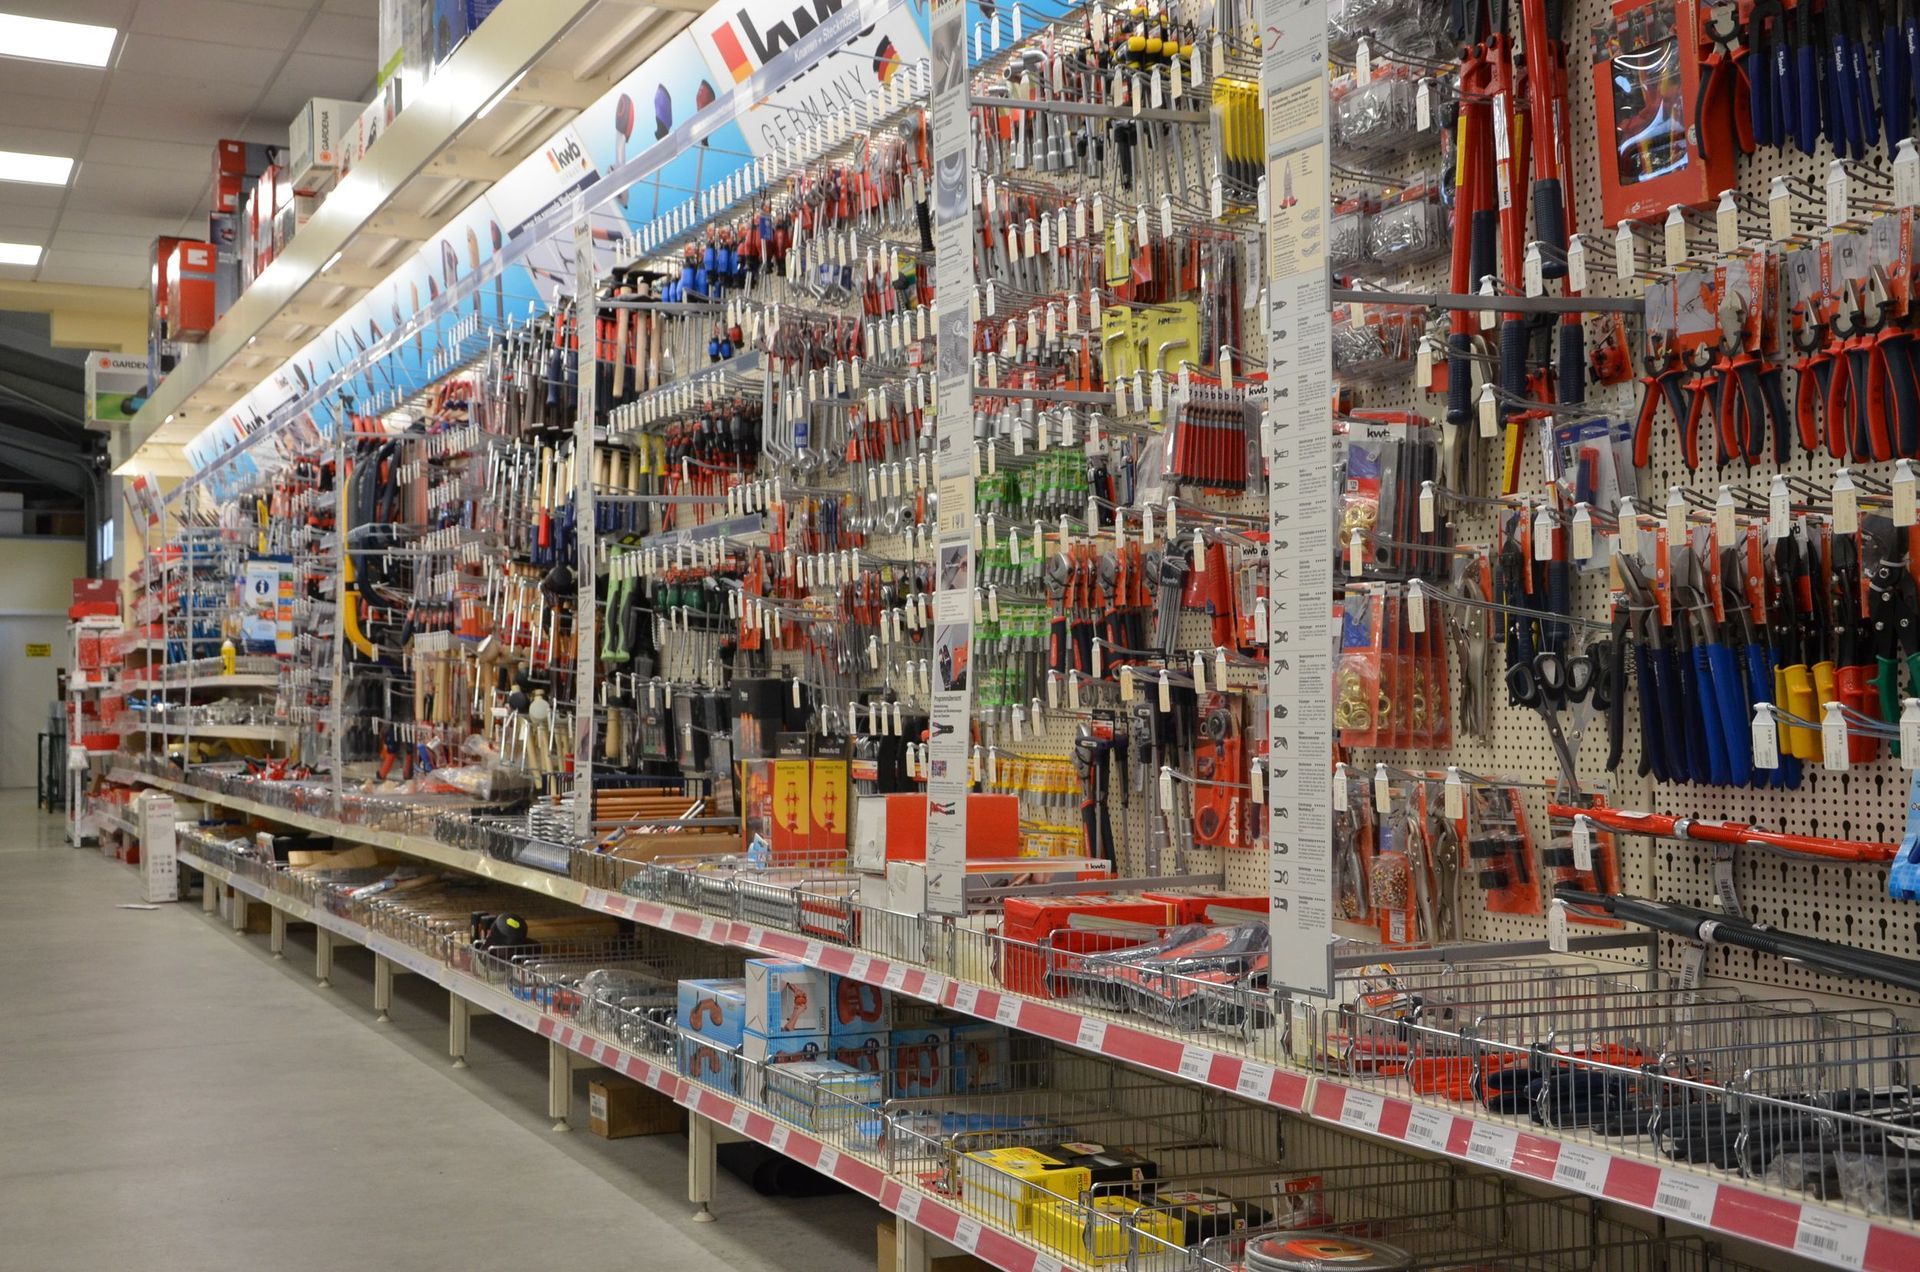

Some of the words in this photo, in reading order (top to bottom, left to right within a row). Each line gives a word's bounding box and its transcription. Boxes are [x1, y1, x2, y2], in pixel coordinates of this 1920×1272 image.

[1778, 55, 1786, 76] kwb
[1835, 51, 1844, 72] kwb
[760, 64, 869, 151] GERMANY
[321, 110, 329, 151] GARDENA
[551, 136, 581, 169] kwb
[112, 360, 148, 369] GARDEN
[1249, 384, 1268, 396] kwb
[1243, 546, 1259, 556] kwb
[1229, 797, 1239, 845] kwb
[1090, 862, 1106, 870] kwb
